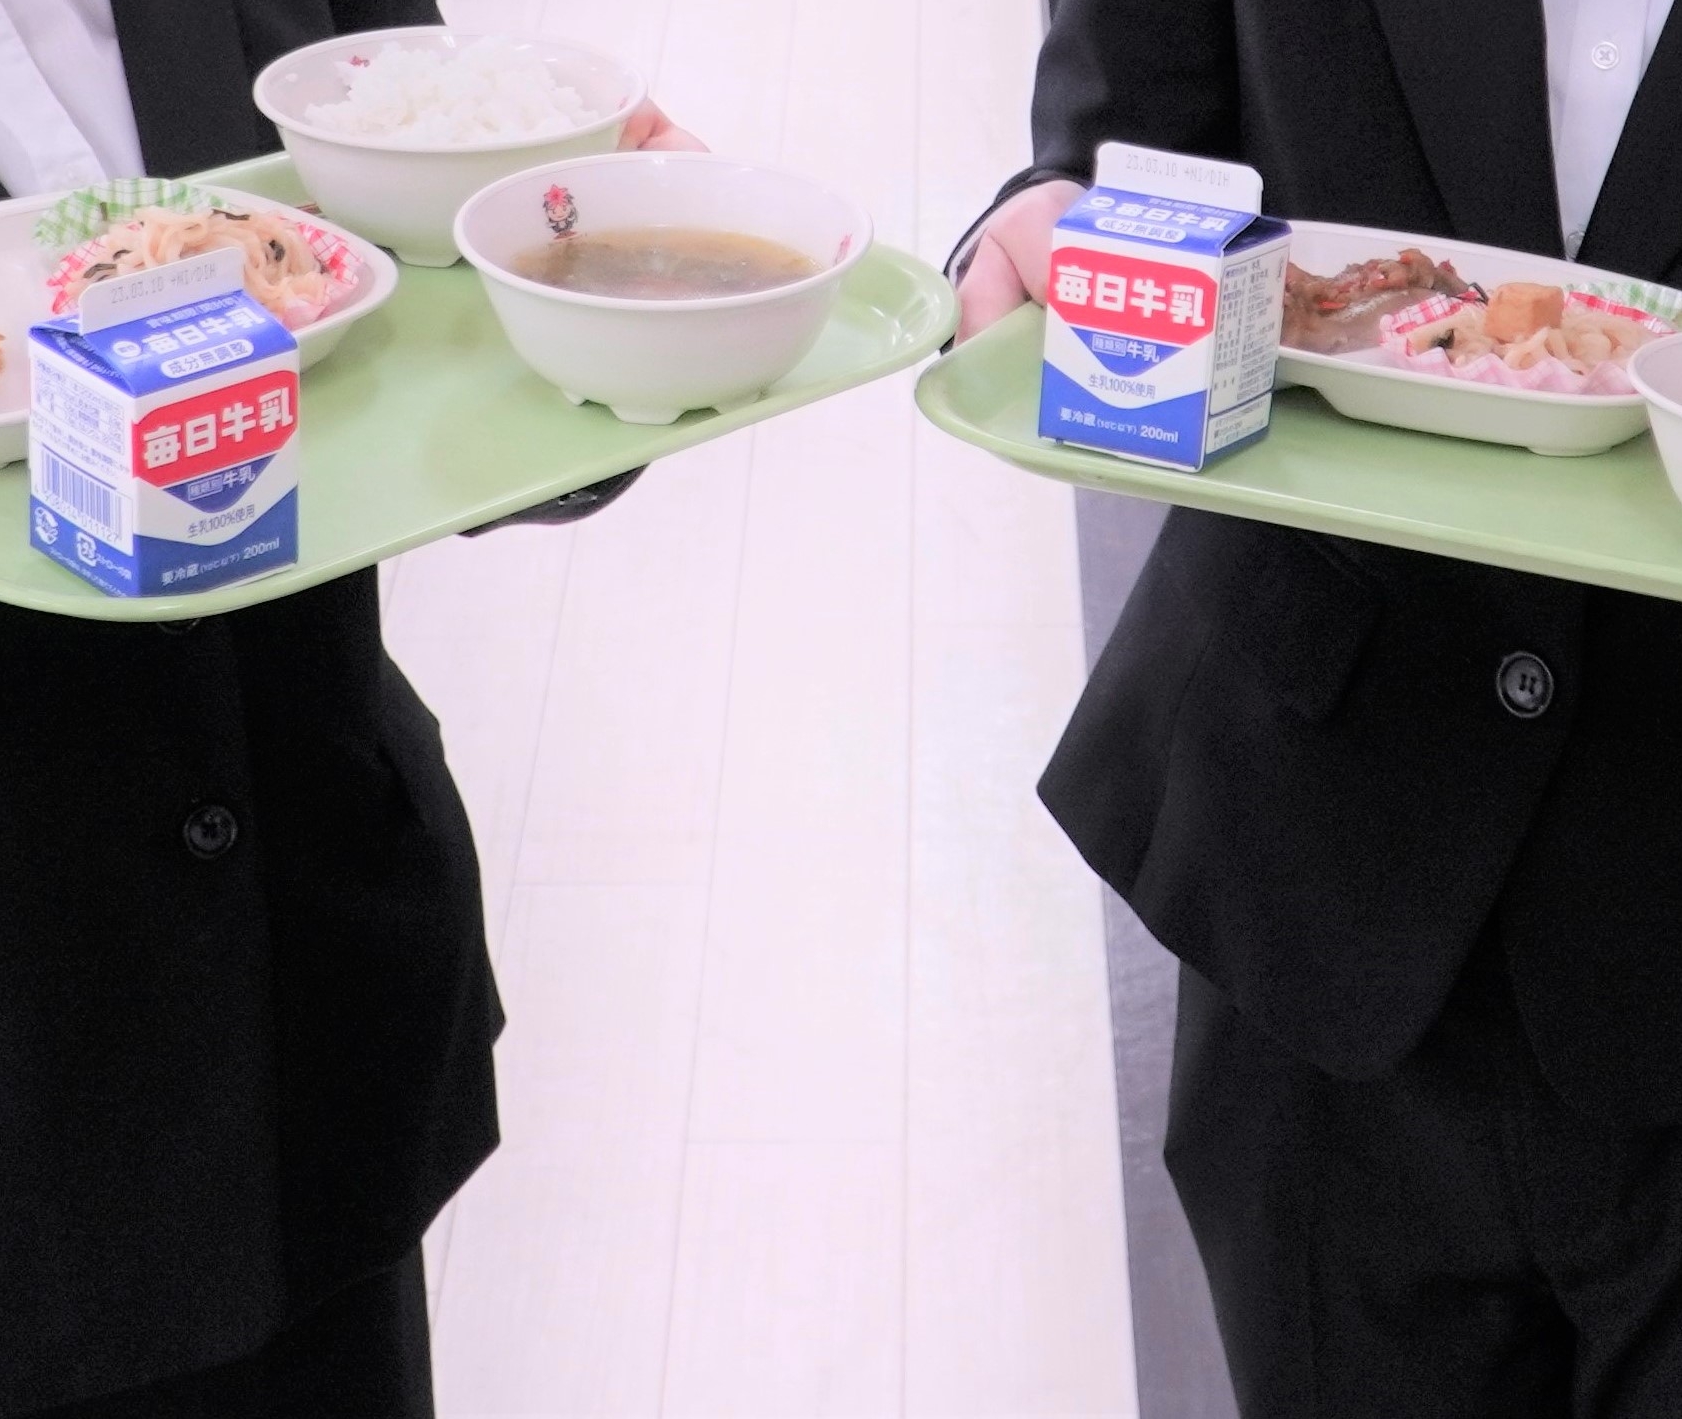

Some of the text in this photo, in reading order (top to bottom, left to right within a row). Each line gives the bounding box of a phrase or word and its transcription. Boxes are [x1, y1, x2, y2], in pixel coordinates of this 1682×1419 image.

[1101, 217, 1182, 242] 成分無調整
[1115, 202, 1230, 231] 毎日牛乳
[1055, 264, 1206, 327] 毎日牛乳
[142, 307, 266, 354] 毎日牛乳
[168, 340, 250, 375] 成分無調整
[1087, 373, 1157, 400] 生乳100%使用
[142, 387, 295, 469] 毎日牛乳
[1139, 425, 1179, 444] 200ml
[187, 503, 256, 539] 生乳100%使用
[243, 537, 280, 560] 200ml
